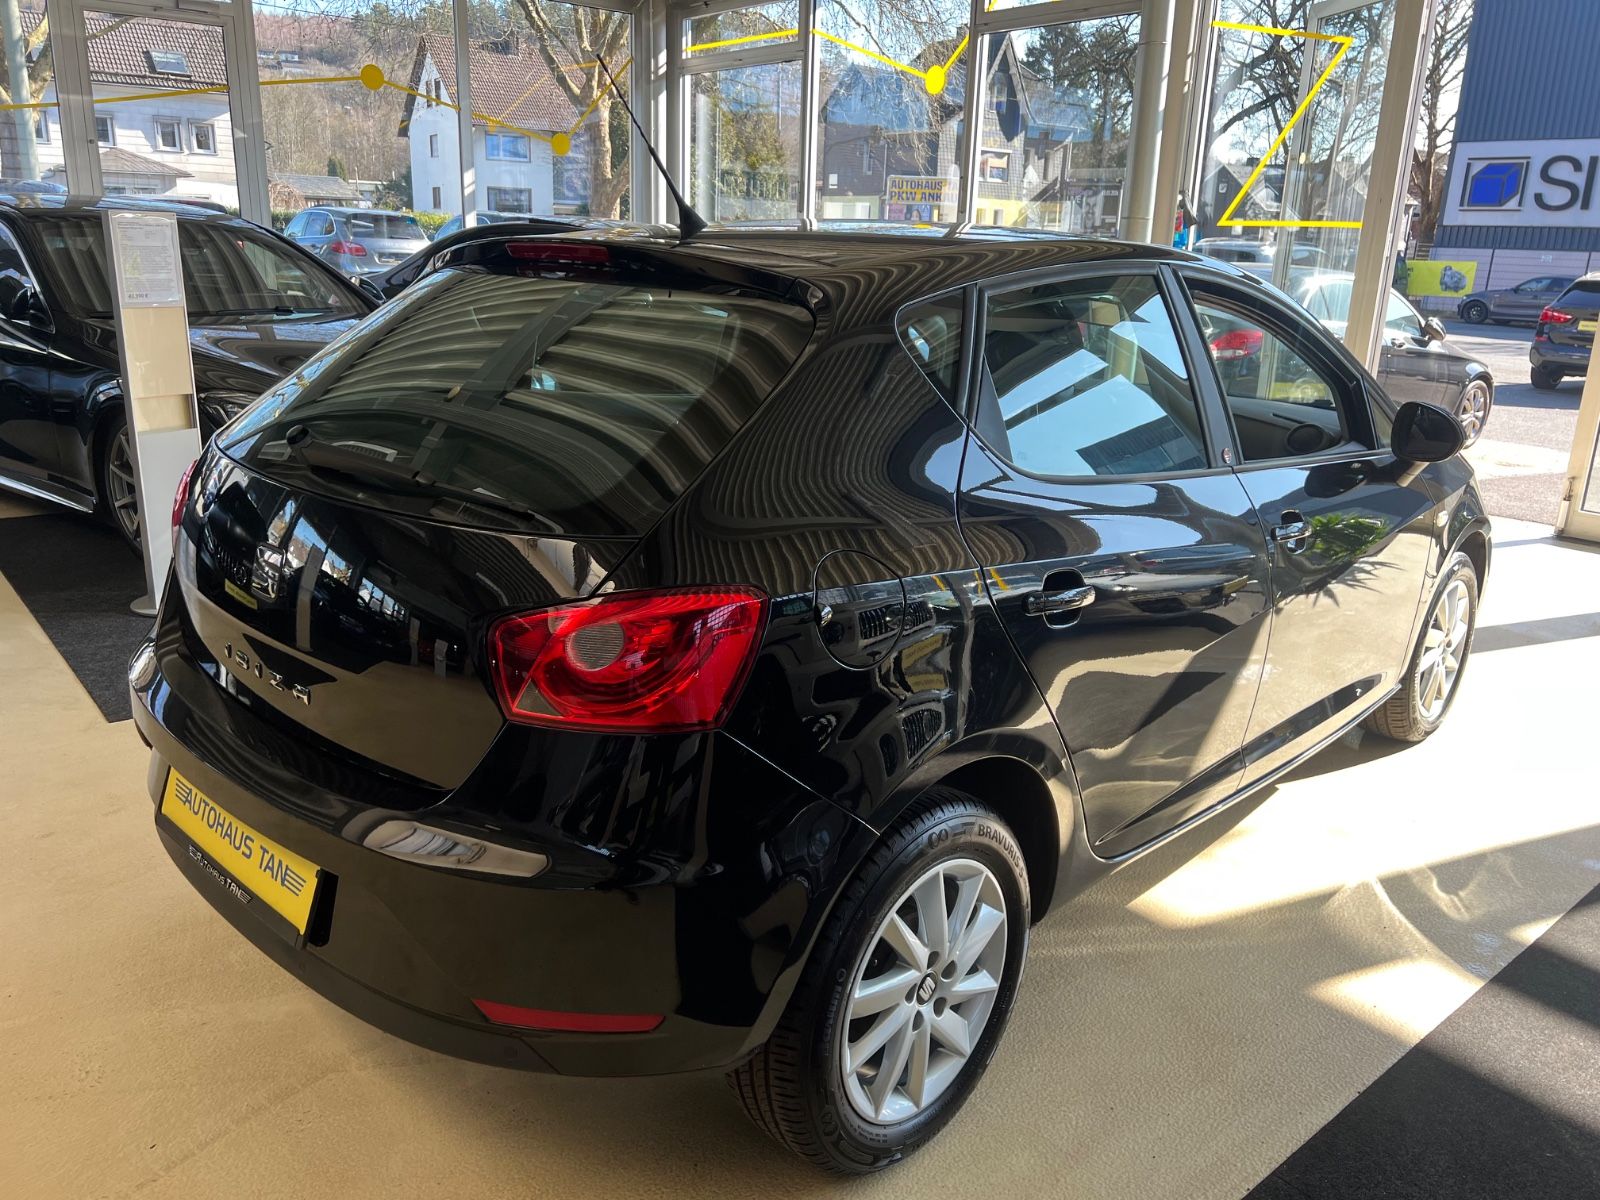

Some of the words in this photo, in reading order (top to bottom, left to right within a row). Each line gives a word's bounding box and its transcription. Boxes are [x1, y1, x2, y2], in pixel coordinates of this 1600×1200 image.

[890, 190, 917, 201] PKW
[891, 180, 943, 190] AUTOHAUS
[225, 641, 311, 706] IBIZA
[184, 788, 255, 860] AUTOHAUS
[259, 845, 289, 887] TAN
[977, 823, 1021, 868] BRAVURIS
[196, 851, 226, 885] AUTOHAUS
[226, 878, 242, 899] TAN
